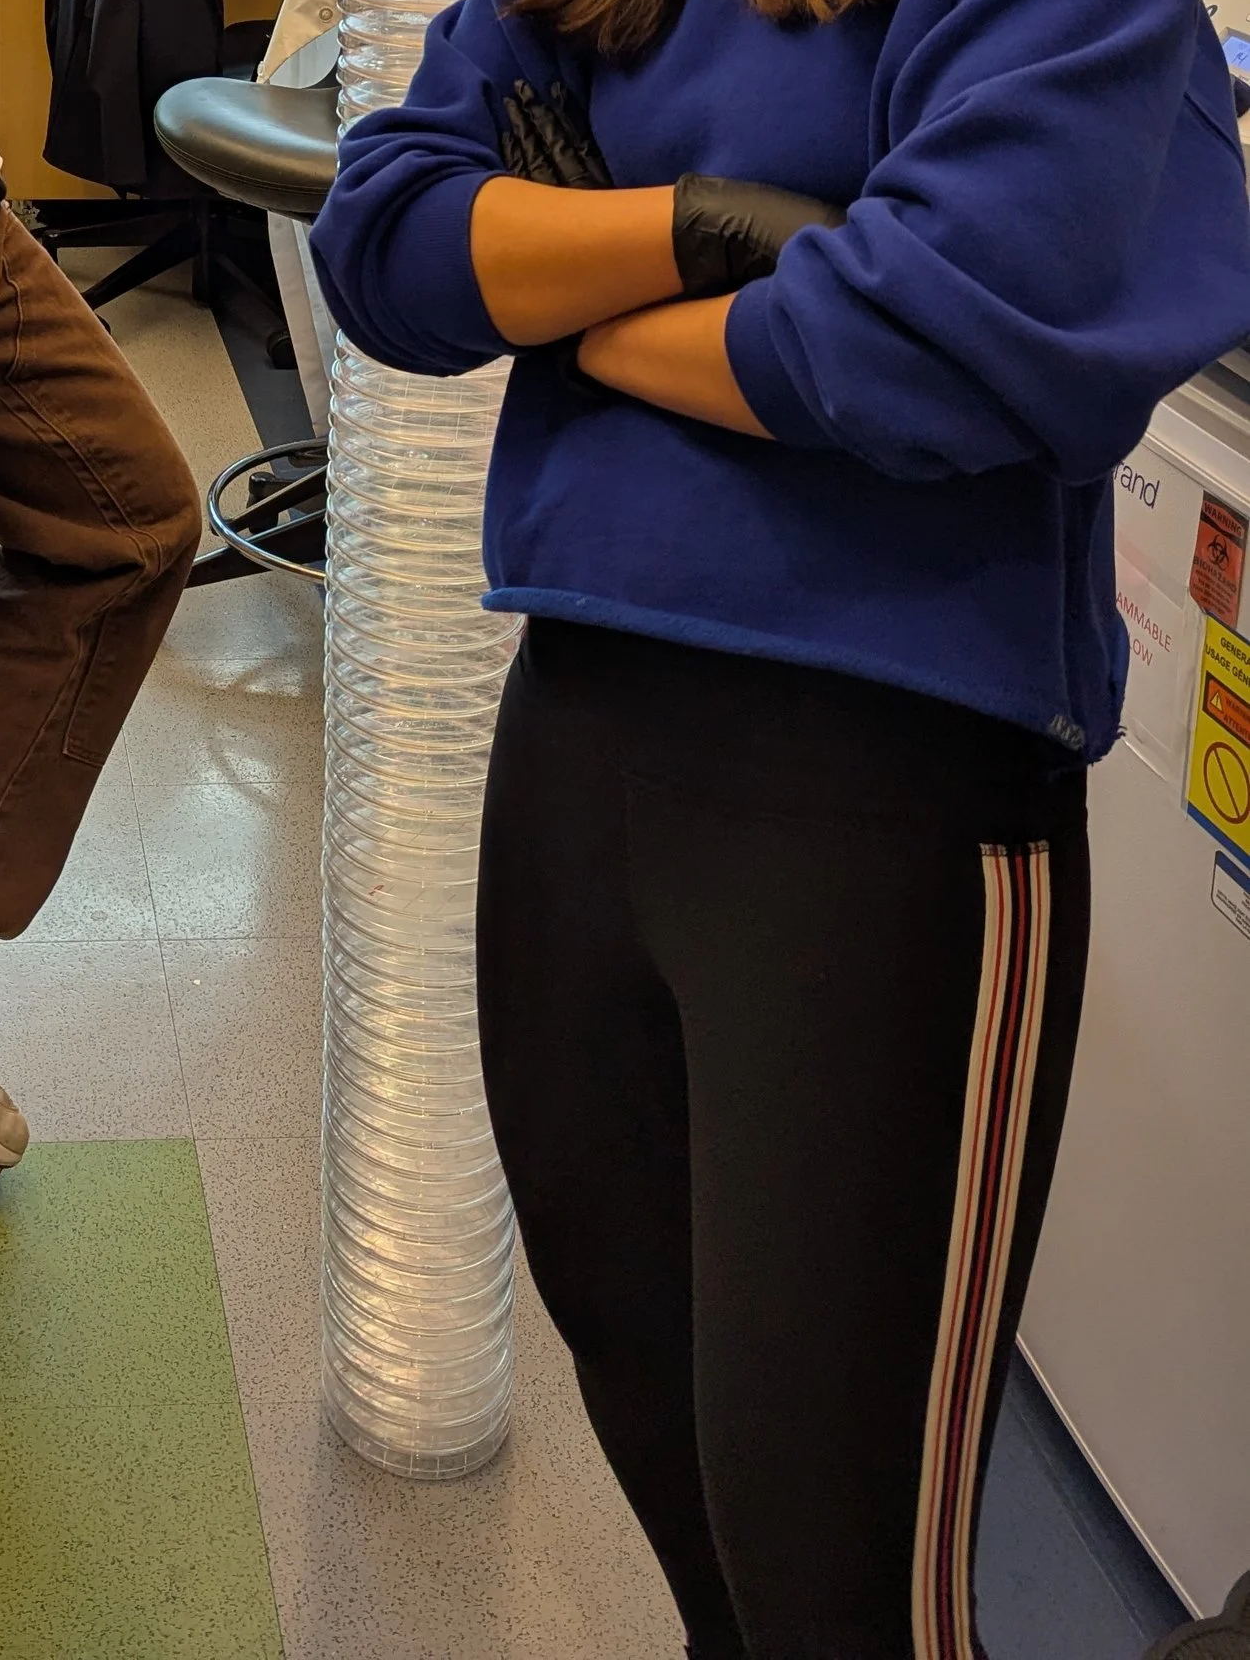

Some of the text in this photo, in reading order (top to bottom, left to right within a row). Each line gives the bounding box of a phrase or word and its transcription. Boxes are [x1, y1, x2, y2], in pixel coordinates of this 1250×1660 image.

[1203, 502, 1242, 537] WARNING
[1193, 555, 1237, 593] BIOHAZARD
[1205, 643, 1250, 688] USAGE GÉN
